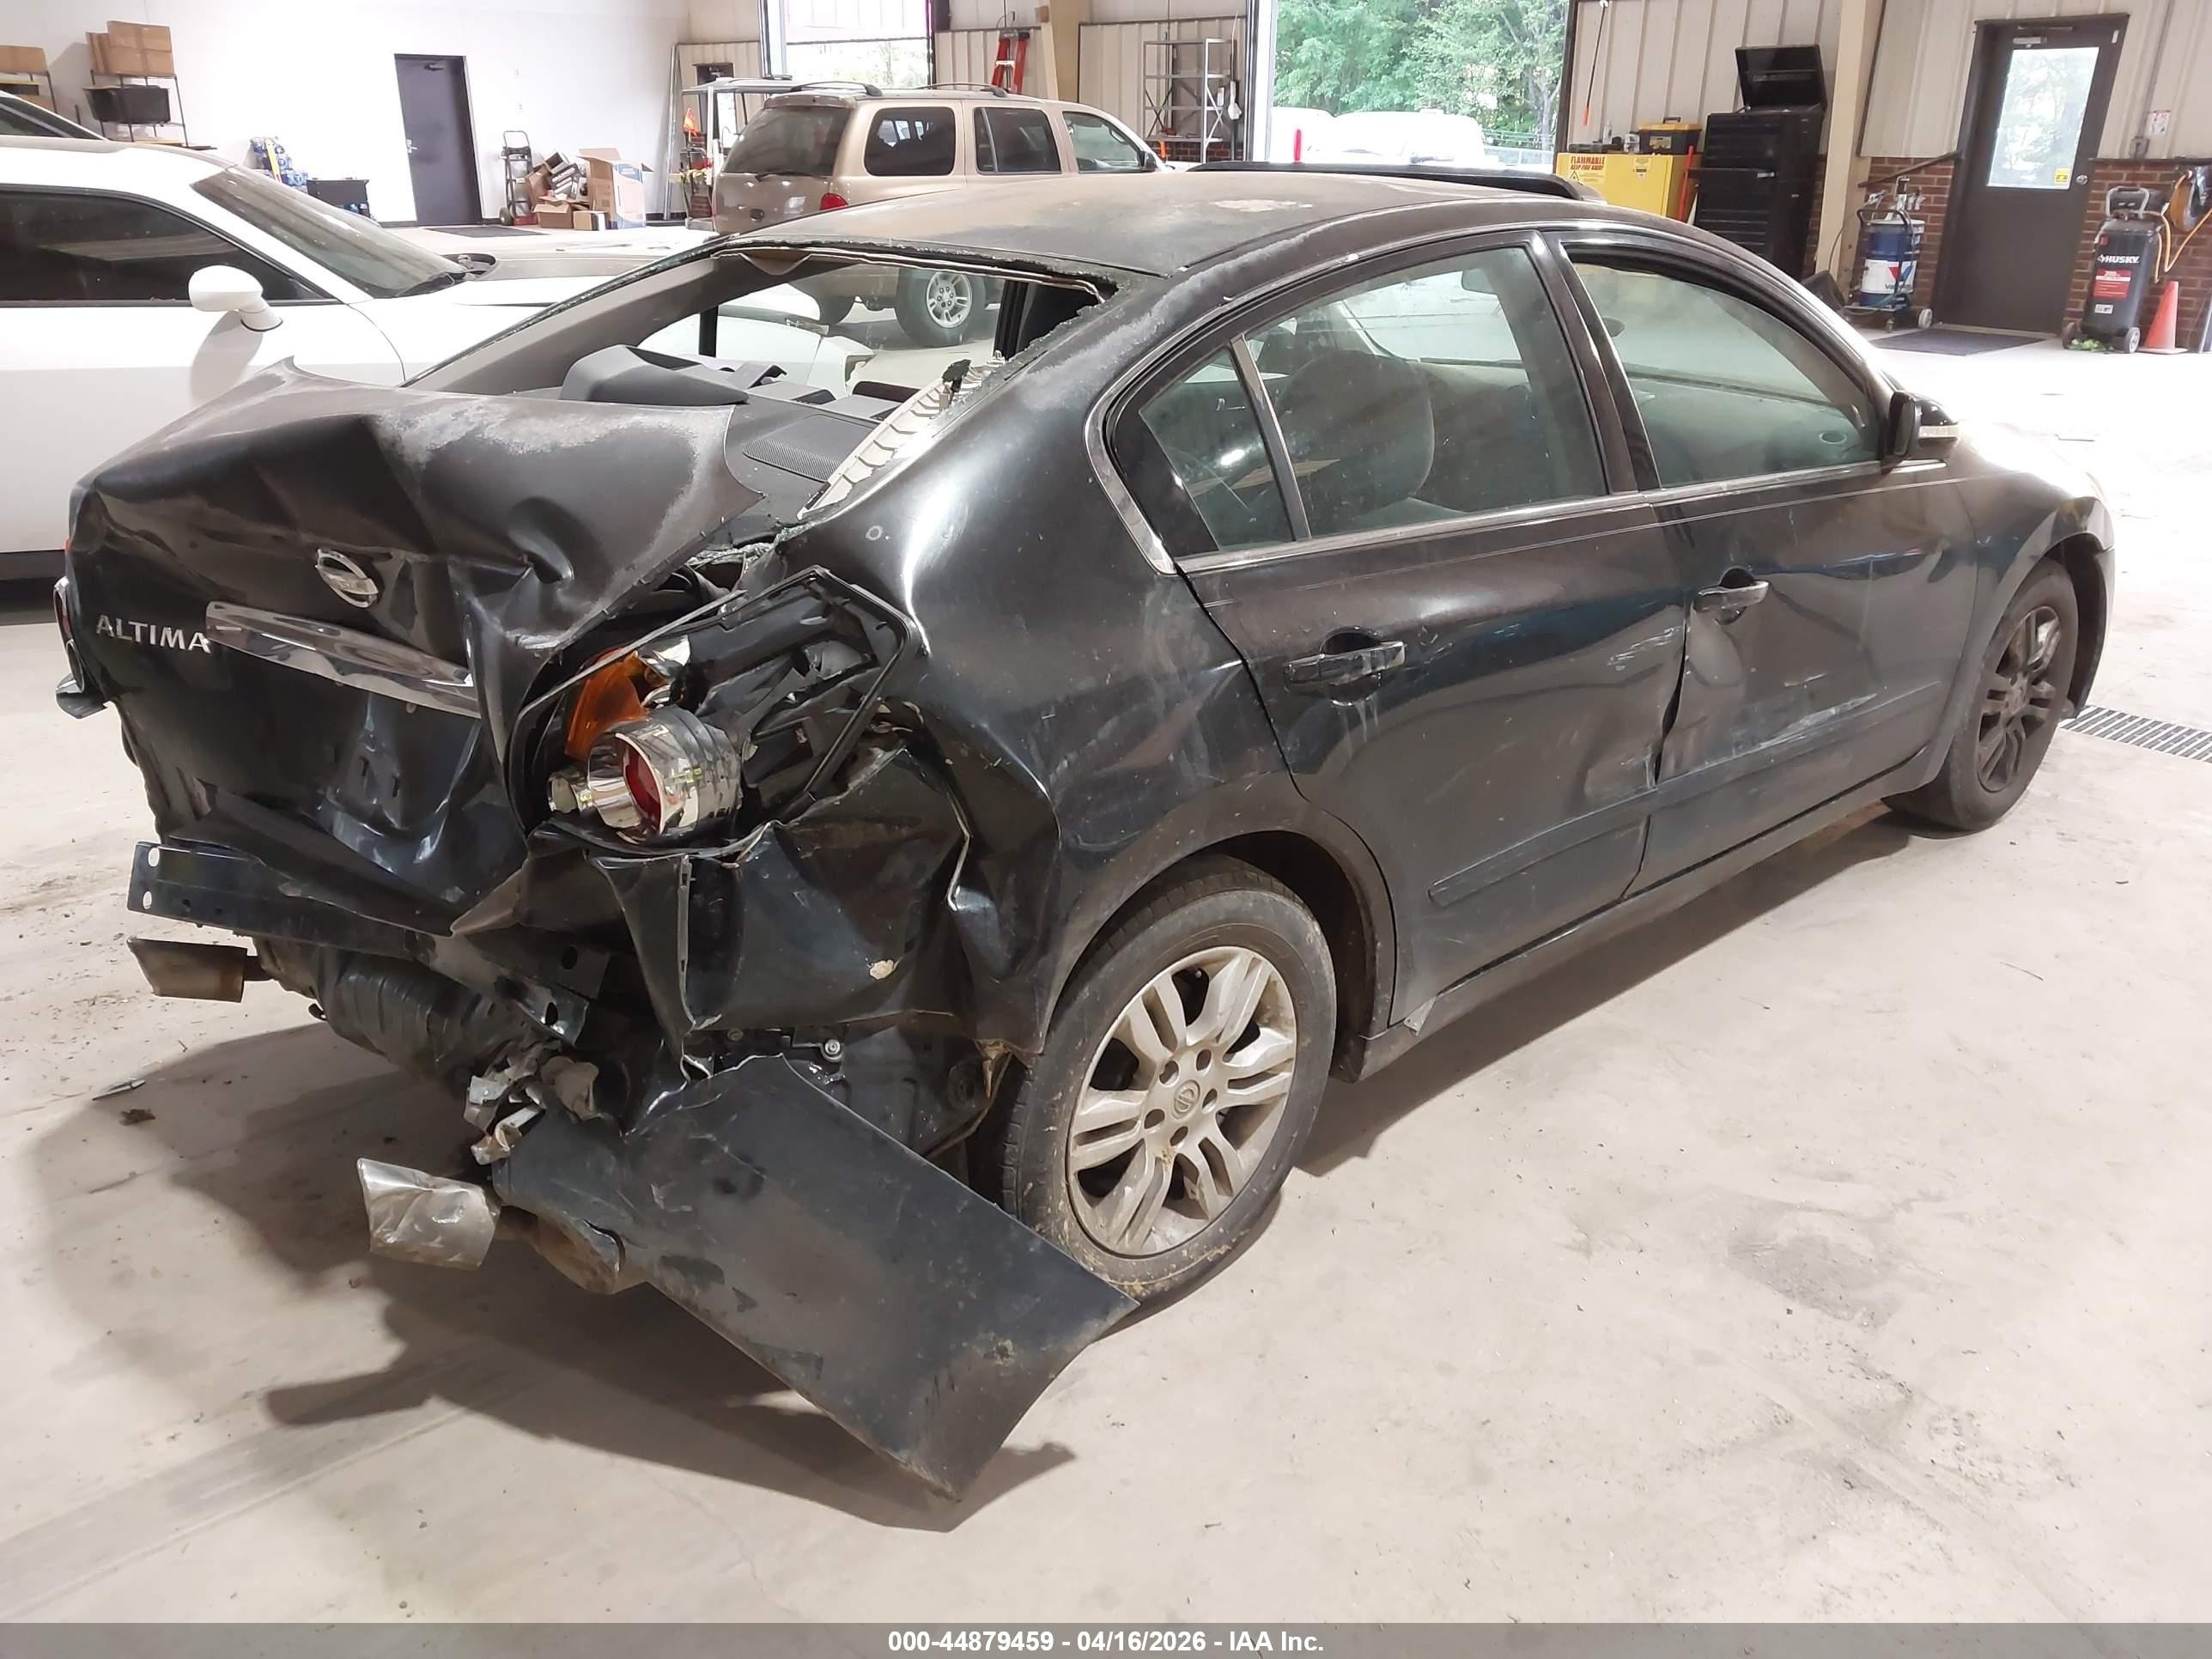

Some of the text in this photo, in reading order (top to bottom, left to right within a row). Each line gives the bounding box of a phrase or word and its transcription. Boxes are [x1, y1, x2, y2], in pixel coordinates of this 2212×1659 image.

[1571, 155, 1606, 165] FLAMMABLE
[2105, 255, 2140, 264] HUSKY
[95, 614, 212, 654] ALTIMA
